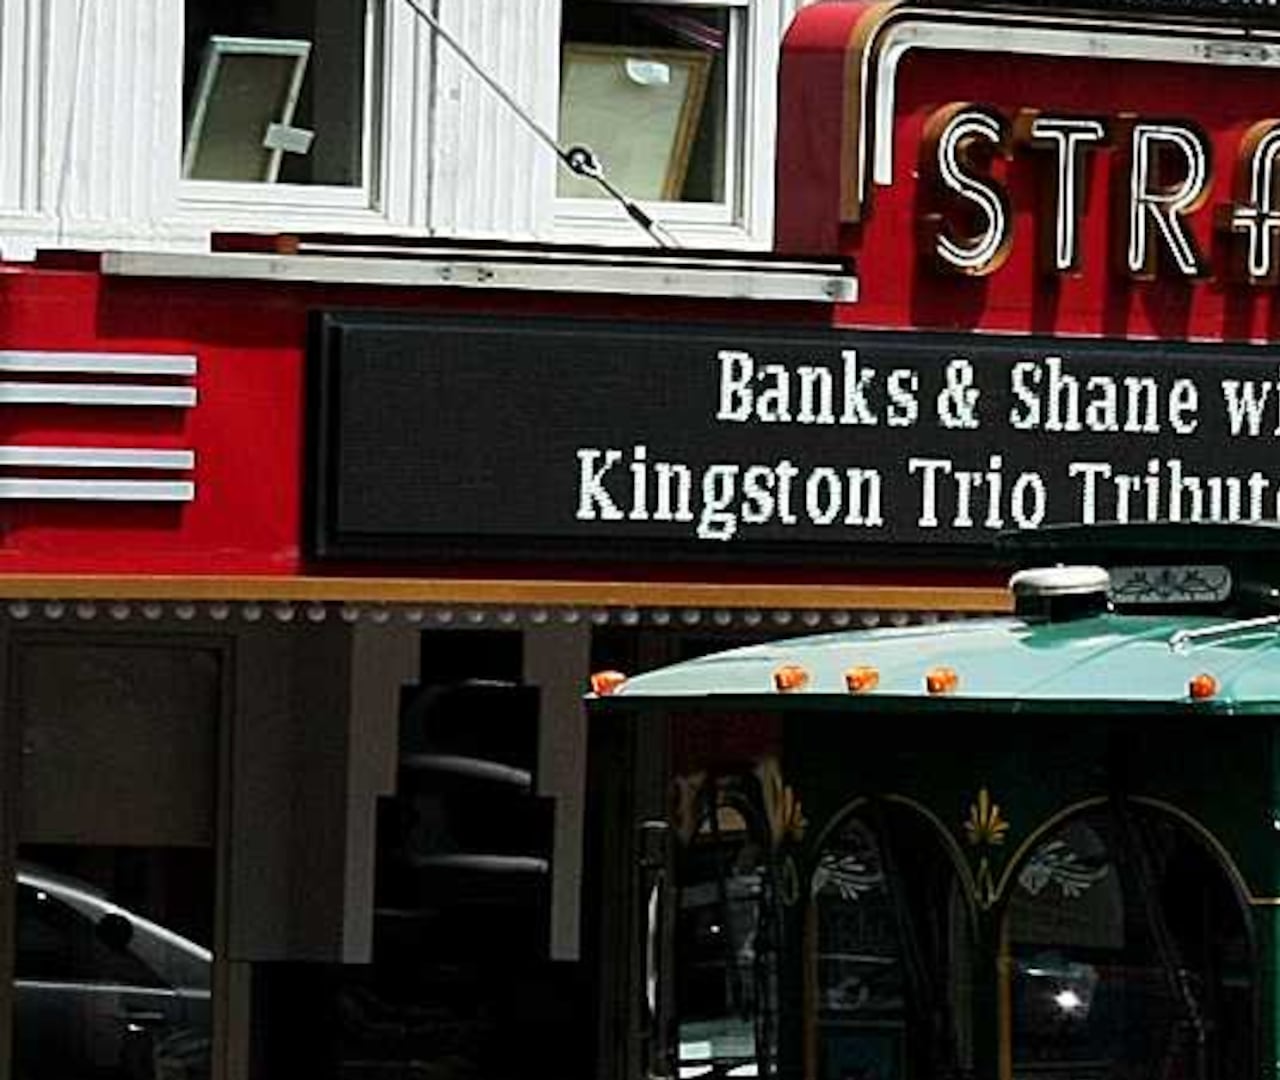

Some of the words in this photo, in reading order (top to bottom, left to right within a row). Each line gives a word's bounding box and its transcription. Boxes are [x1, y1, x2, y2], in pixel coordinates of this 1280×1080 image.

[716, 349, 919, 428] Banks
[937, 359, 981, 430] &
[1009, 356, 1199, 434] Shane
[576, 445, 884, 541] Kingston
[908, 454, 1048, 531] Trio
